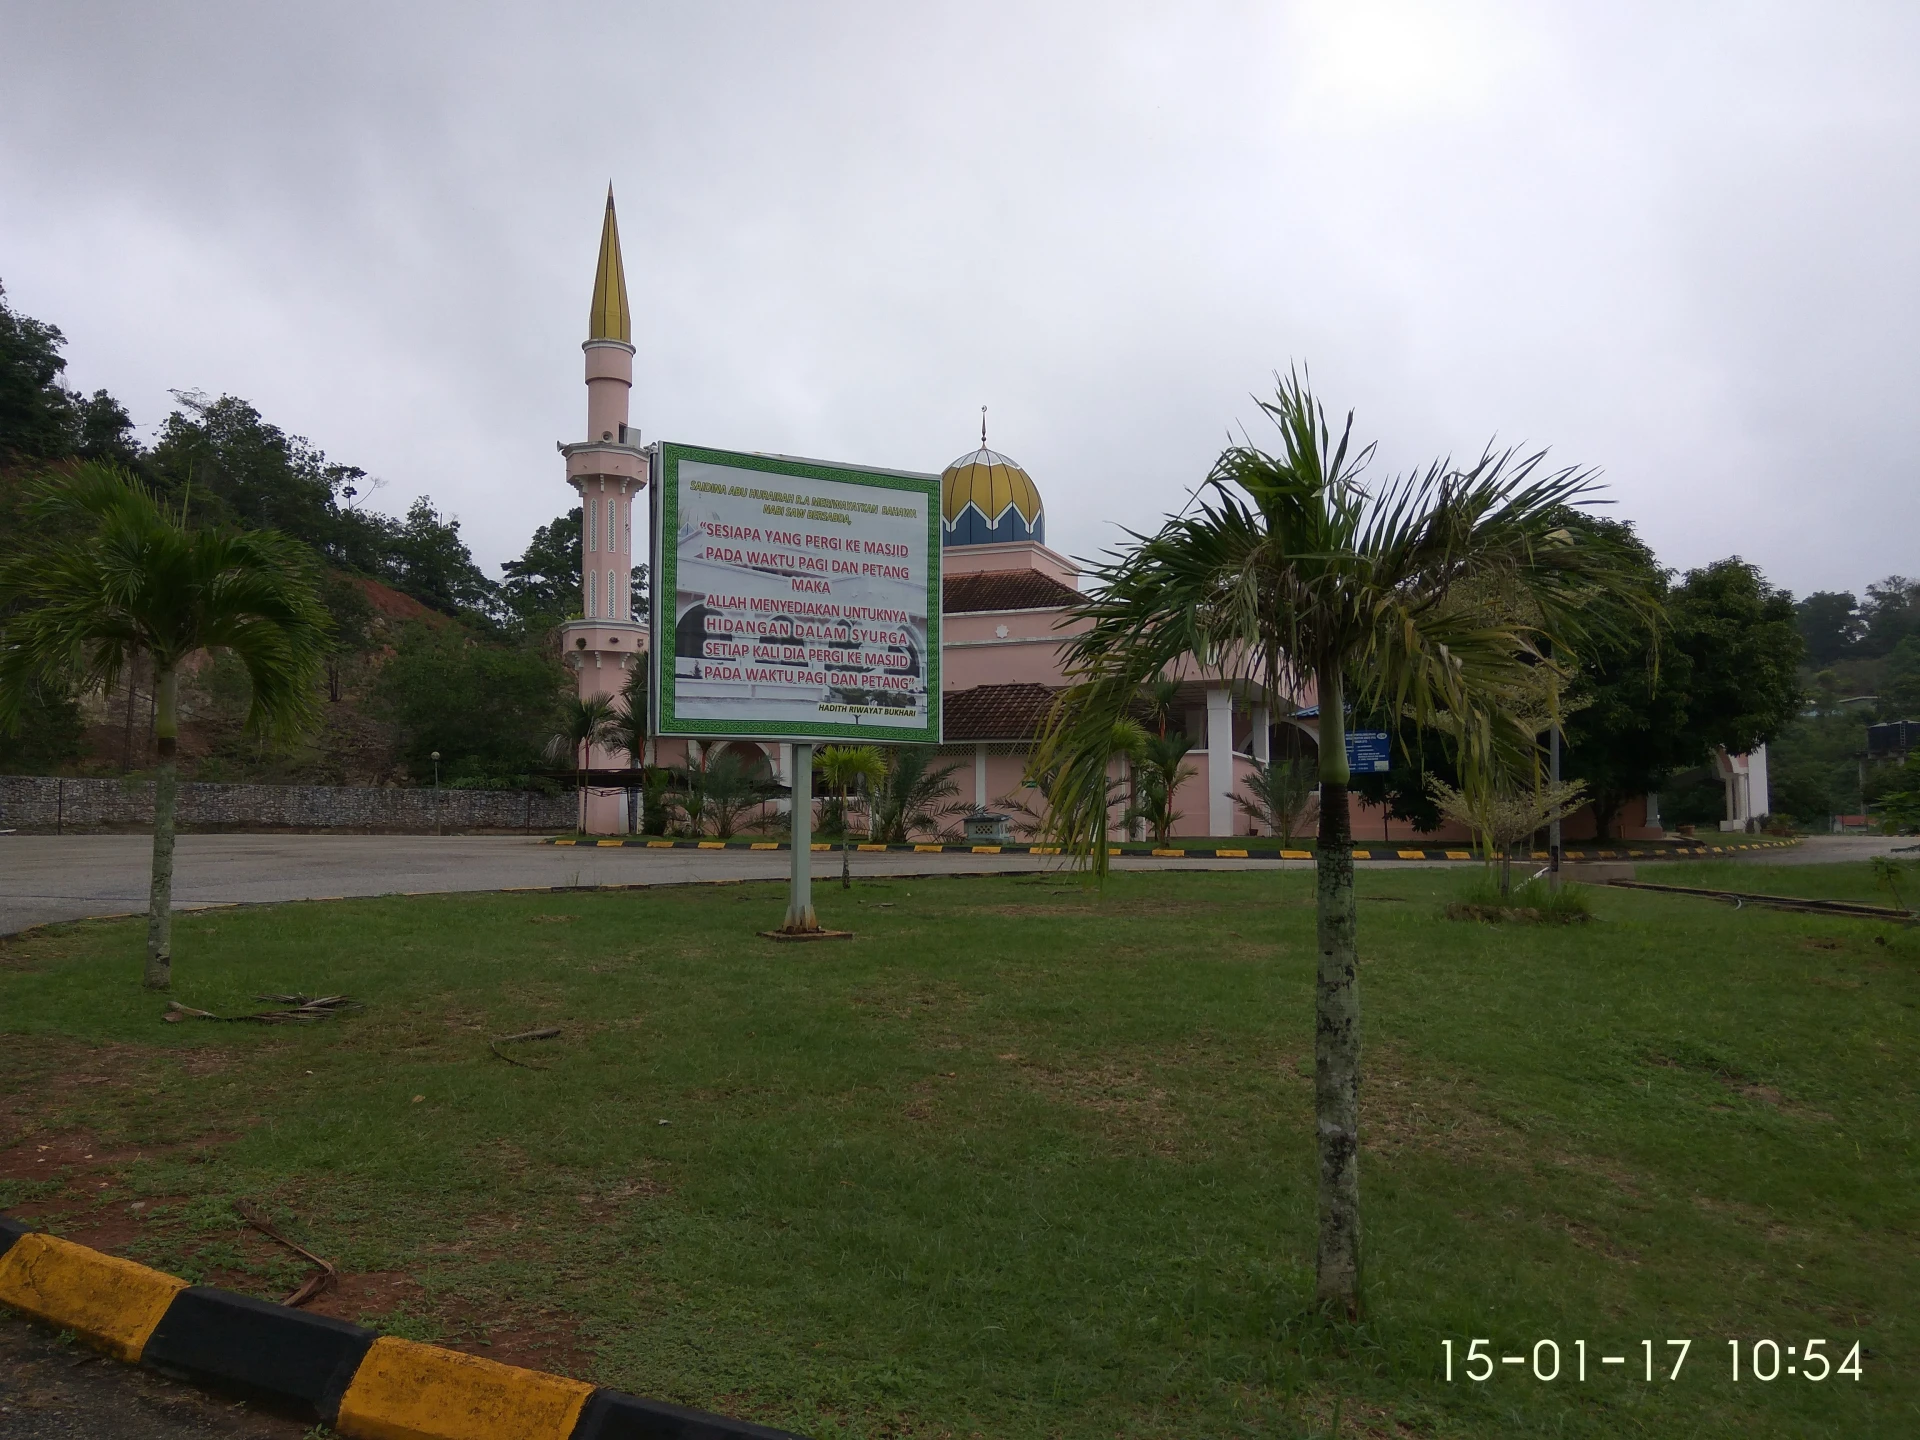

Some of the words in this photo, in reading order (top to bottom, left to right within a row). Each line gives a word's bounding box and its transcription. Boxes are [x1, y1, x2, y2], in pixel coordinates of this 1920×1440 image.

[690, 480, 726, 495] SAIDINA
[728, 486, 748, 498] ABU
[763, 504, 785, 516] NABI
[786, 507, 806, 518] SAW
[700, 521, 761, 542] “SESIAPA
[765, 529, 801, 546] YANG
[805, 534, 841, 550] PERGI
[845, 539, 860, 553] KE
[864, 541, 908, 558] MASJID
[706, 546, 743, 563] PADA
[746, 550, 794, 568] WAKTU
[798, 556, 828, 571] PAGI
[832, 559, 859, 575] DAN
[862, 563, 909, 580] PETANG
[792, 578, 831, 594] MAKA
[706, 594, 747, 610] ALLAH
[750, 597, 840, 617] MENYEDIAKAN
[843, 605, 907, 622] UNTUKNYA
[706, 617, 789, 635] HIDANGAN
[795, 624, 846, 640] DALAM
[852, 628, 907, 645] SYURGA
[705, 642, 749, 657] SETIAP
[753, 645, 780, 659] KALI
[783, 647, 805, 660] DIA
[809, 648, 843, 663] PERGI
[847, 651, 861, 664] KE
[865, 653, 908, 668] MASJID
[704, 666, 741, 680] PADA
[745, 667, 793, 682] WAKTU
[798, 671, 827, 685] PAGI
[831, 672, 857, 686] DAN
[818, 704, 848, 713] HADITH
[848, 705, 883, 714] RIWAYAT
[884, 708, 916, 717] BUKHARI
